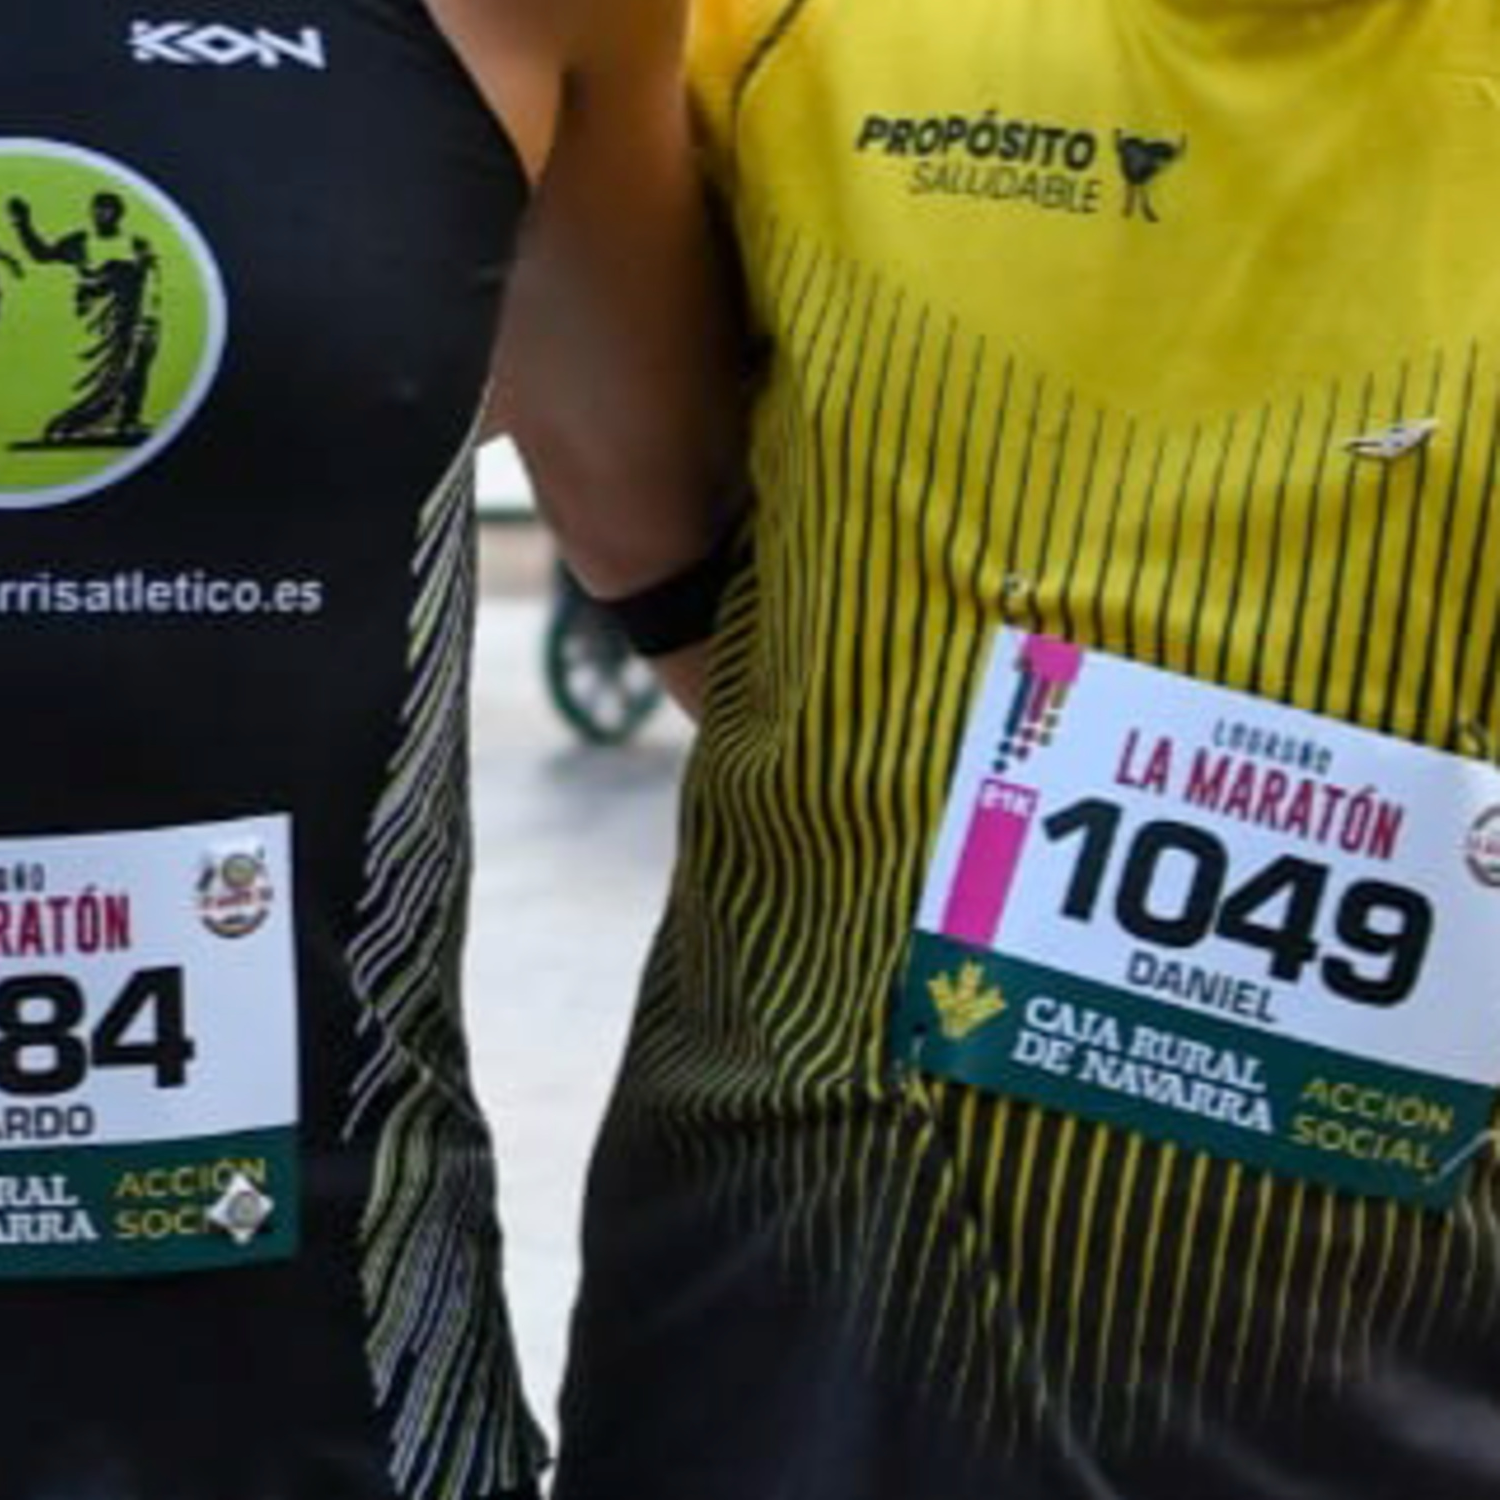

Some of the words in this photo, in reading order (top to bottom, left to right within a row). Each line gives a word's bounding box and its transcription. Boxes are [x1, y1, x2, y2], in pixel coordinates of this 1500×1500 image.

[855, 108, 1097, 171] PROPÓSITO
[908, 162, 1103, 213] SALUDABLE
[1114, 728, 1173, 794] LA
[1182, 747, 1405, 861] MARATÓN
[1042, 797, 1434, 1008] 1049
[1125, 949, 1277, 1022] DANIEL
[1011, 1031, 1070, 1075] DE
[1079, 1045, 1275, 1133] NAVARRA
[1023, 996, 1122, 1052] CAJA
[1128, 1027, 1266, 1093] RURAL
[1290, 1114, 1437, 1170] SOCIAL
